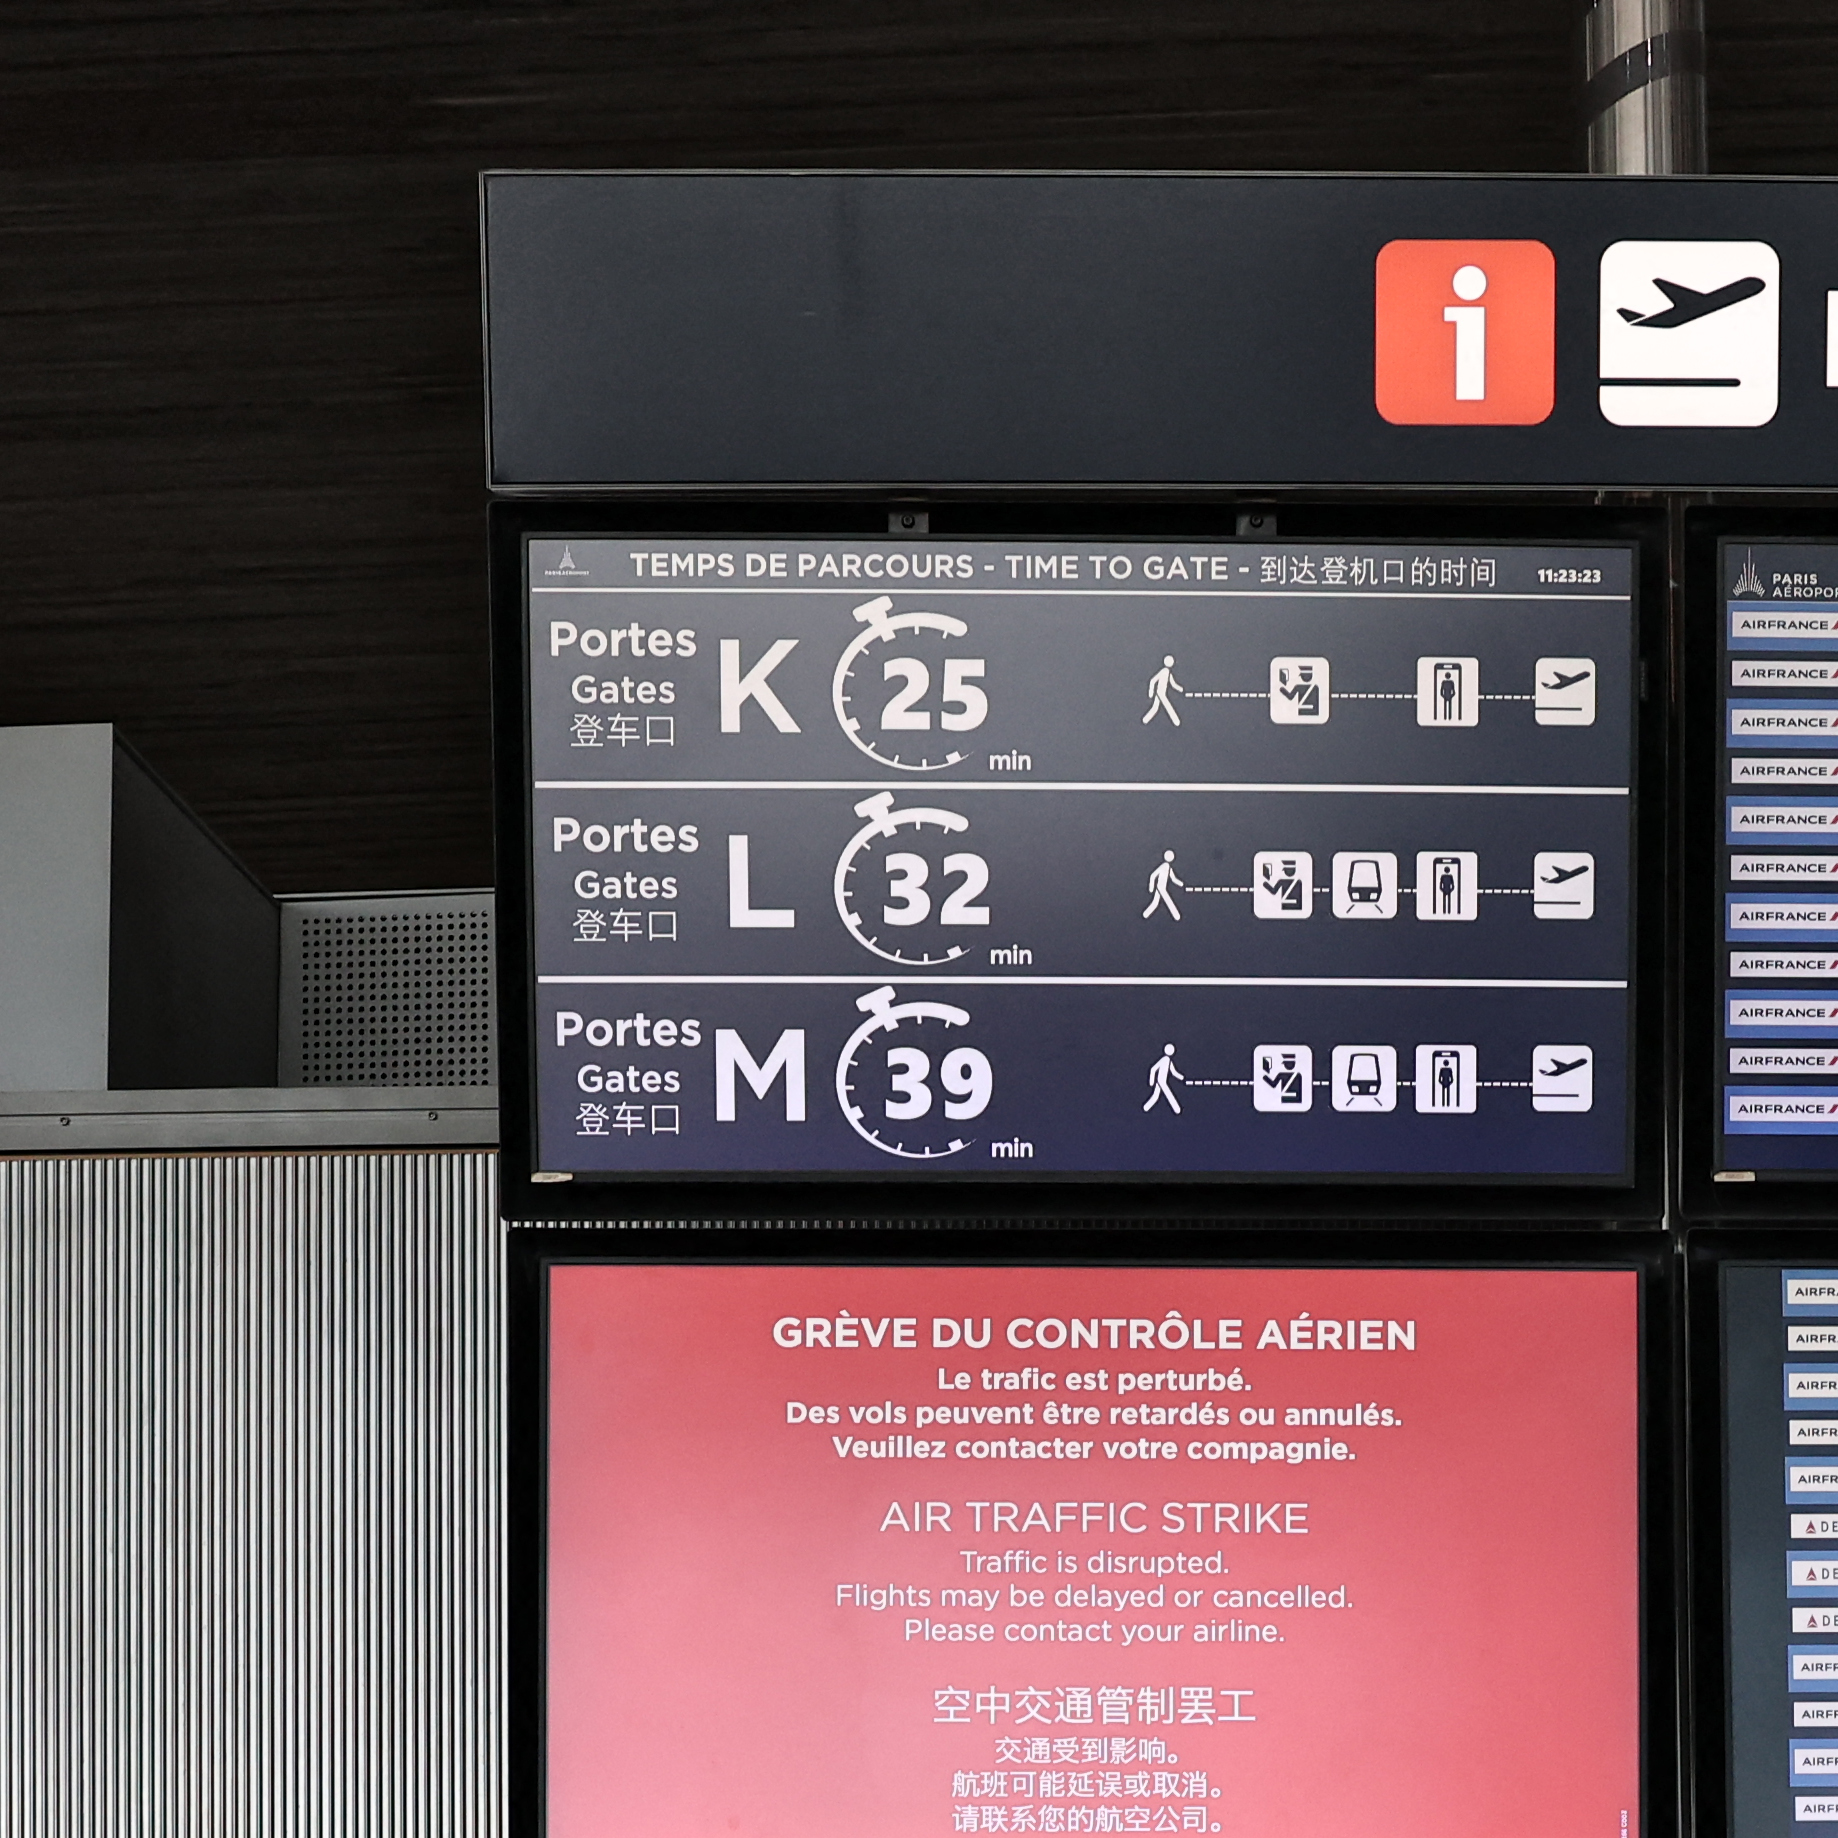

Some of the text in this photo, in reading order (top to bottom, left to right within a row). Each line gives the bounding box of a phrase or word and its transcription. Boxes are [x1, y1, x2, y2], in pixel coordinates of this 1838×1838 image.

[629, 552, 1601, 588] TEMPS DE PARCOURS TIME TO GATE 到达登机口的时间 11:23:23
[550, 621, 697, 657] Portes
[571, 674, 676, 704] Gates
[719, 638, 802, 734] K
[880, 657, 988, 732] 25
[569, 712, 674, 748] 登车口
[989, 749, 1032, 771] min
[553, 817, 699, 853] Portes
[574, 870, 678, 899] Gates
[728, 834, 795, 928] L
[1738, 862, 1827, 873] AIRFRANCE
[883, 852, 990, 926] 32
[572, 907, 677, 943] 登车口
[990, 943, 1033, 965] min
[556, 1011, 702, 1047] Portes
[577, 1064, 681, 1093] Gates
[715, 1028, 806, 1122] M
[885, 1047, 993, 1120] 39
[575, 1101, 680, 1136] 登车口
[991, 1136, 1034, 1158] min
[773, 1309, 1415, 1351] GRÈVE DU CONTRÔLE AÉRIEN
[938, 1367, 1252, 1395] Le trafic est perturbé.
[879, 1501, 1309, 1534] AIR TRAFFIC STRIKE
[959, 1549, 1229, 1578] Traffic is disrupted.
[836, 1583, 1353, 1612] Flights may be delayed or cancelled.
[933, 1685, 1256, 1726] 空中交通管制罢工
[994, 1735, 1178, 1765] 交通受到影响。
[951, 1769, 1221, 1799] 航班可能延误或取消。
[951, 1803, 1221, 1833] 请联系您的航空公司。
